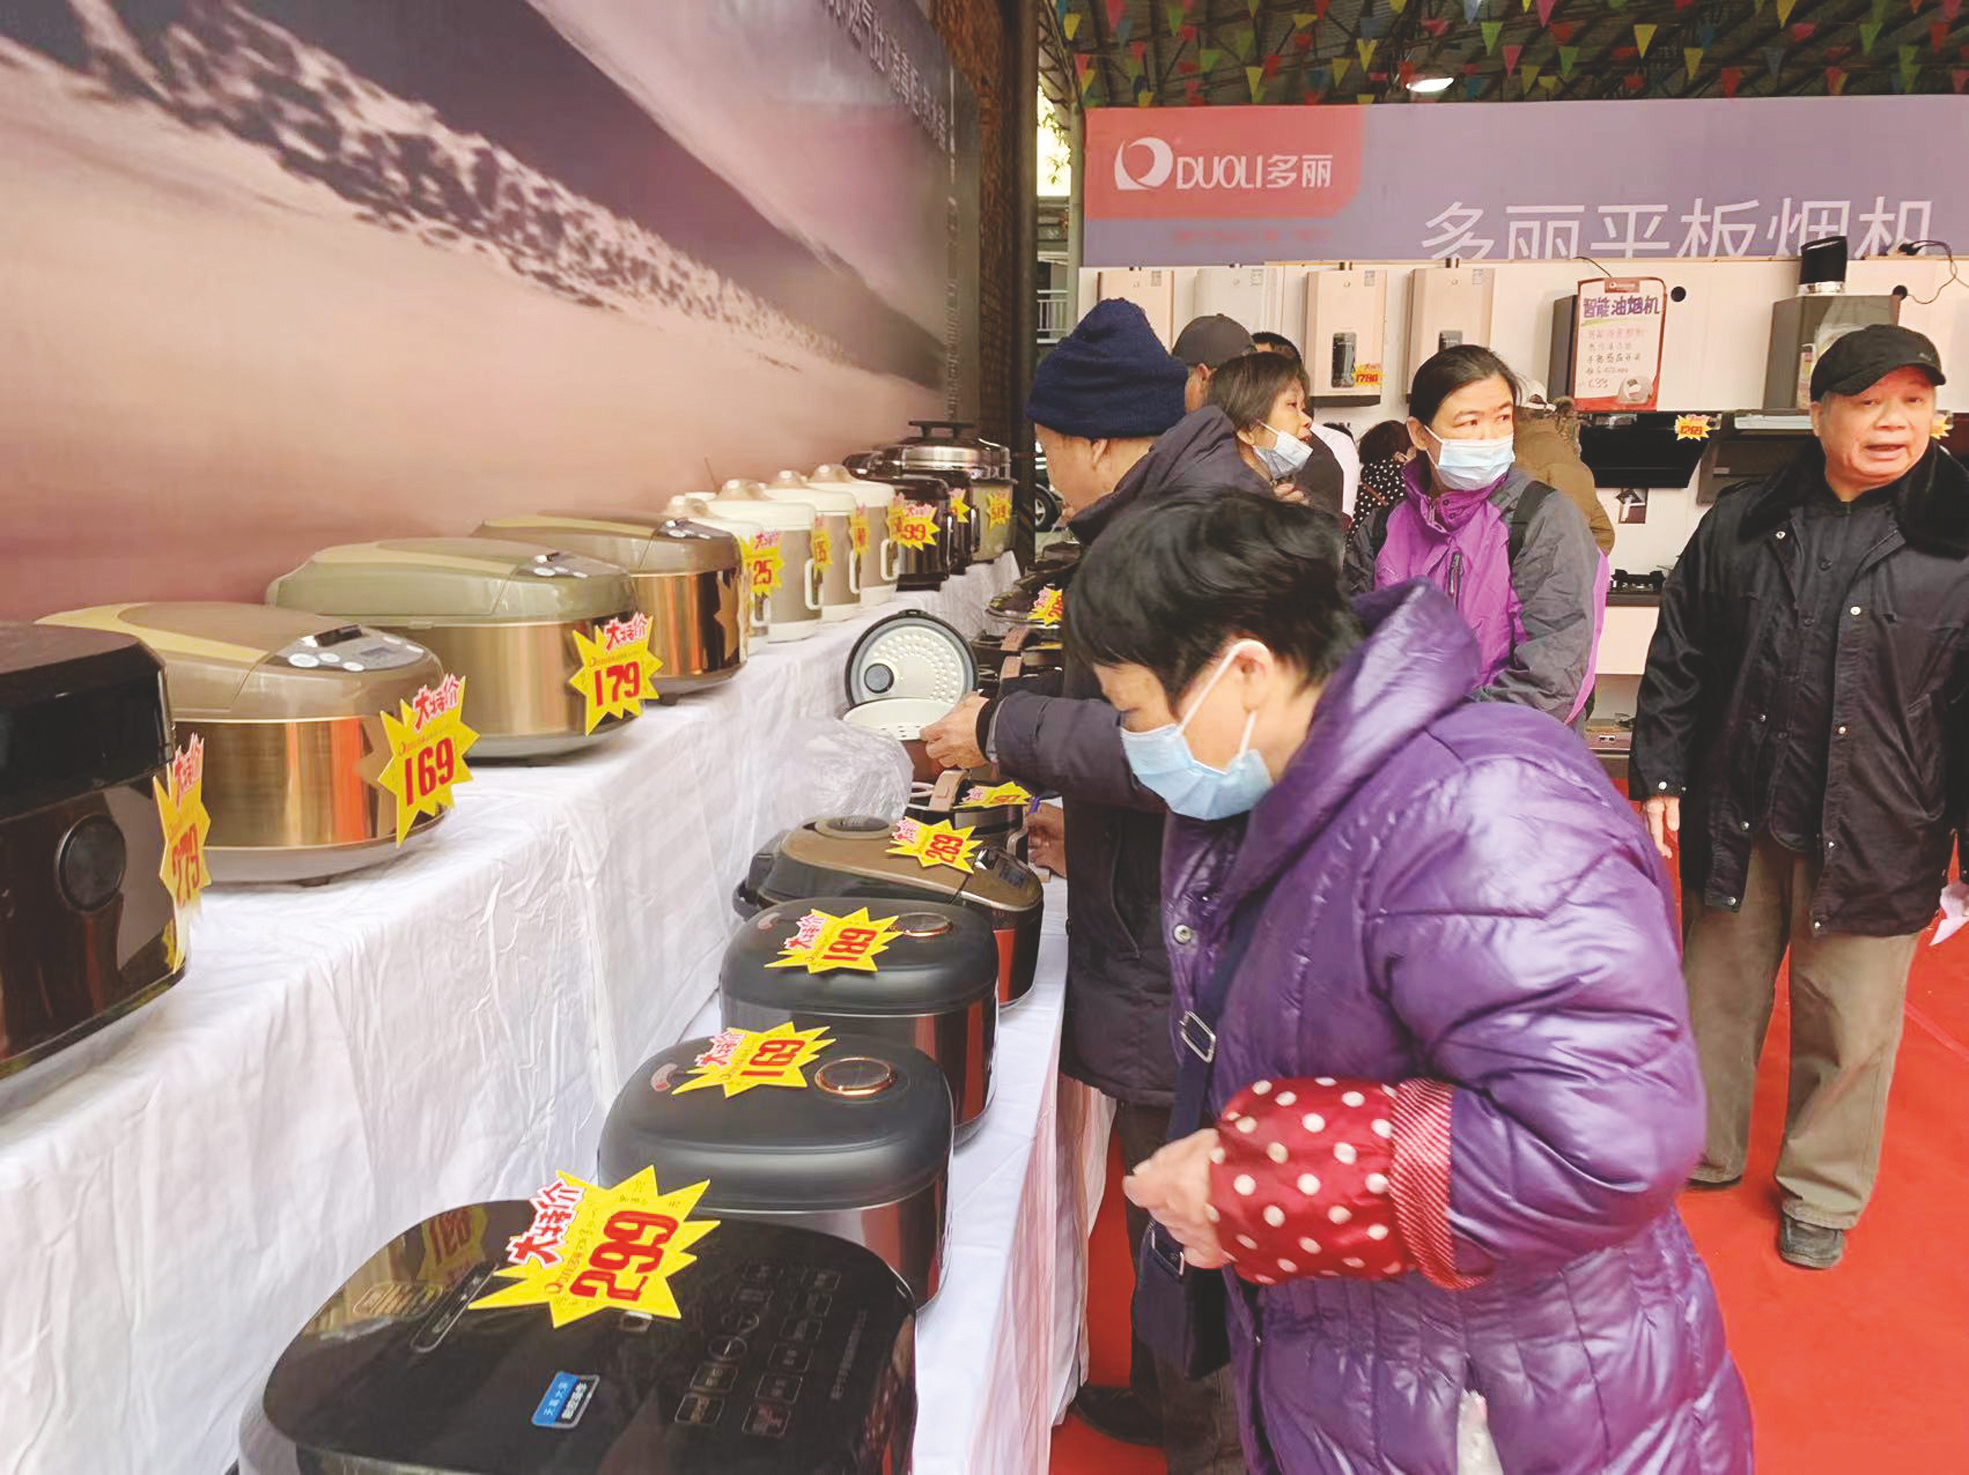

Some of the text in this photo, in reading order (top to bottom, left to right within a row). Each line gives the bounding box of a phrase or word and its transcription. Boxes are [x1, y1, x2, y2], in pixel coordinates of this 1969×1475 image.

[1421, 196, 1933, 259] 多丽平板烟机
[1583, 296, 1661, 318] 智能油烟机
[605, 613, 648, 651] 大特价
[414, 674, 459, 731] 大特价
[594, 661, 641, 707] 179
[404, 738, 455, 806] 169
[925, 834, 963, 863] 269
[823, 928, 877, 962] 189
[695, 1027, 746, 1069] 大特价
[741, 1039, 805, 1077] 169
[509, 1182, 583, 1265] 大特价
[570, 1210, 678, 1301] 299
